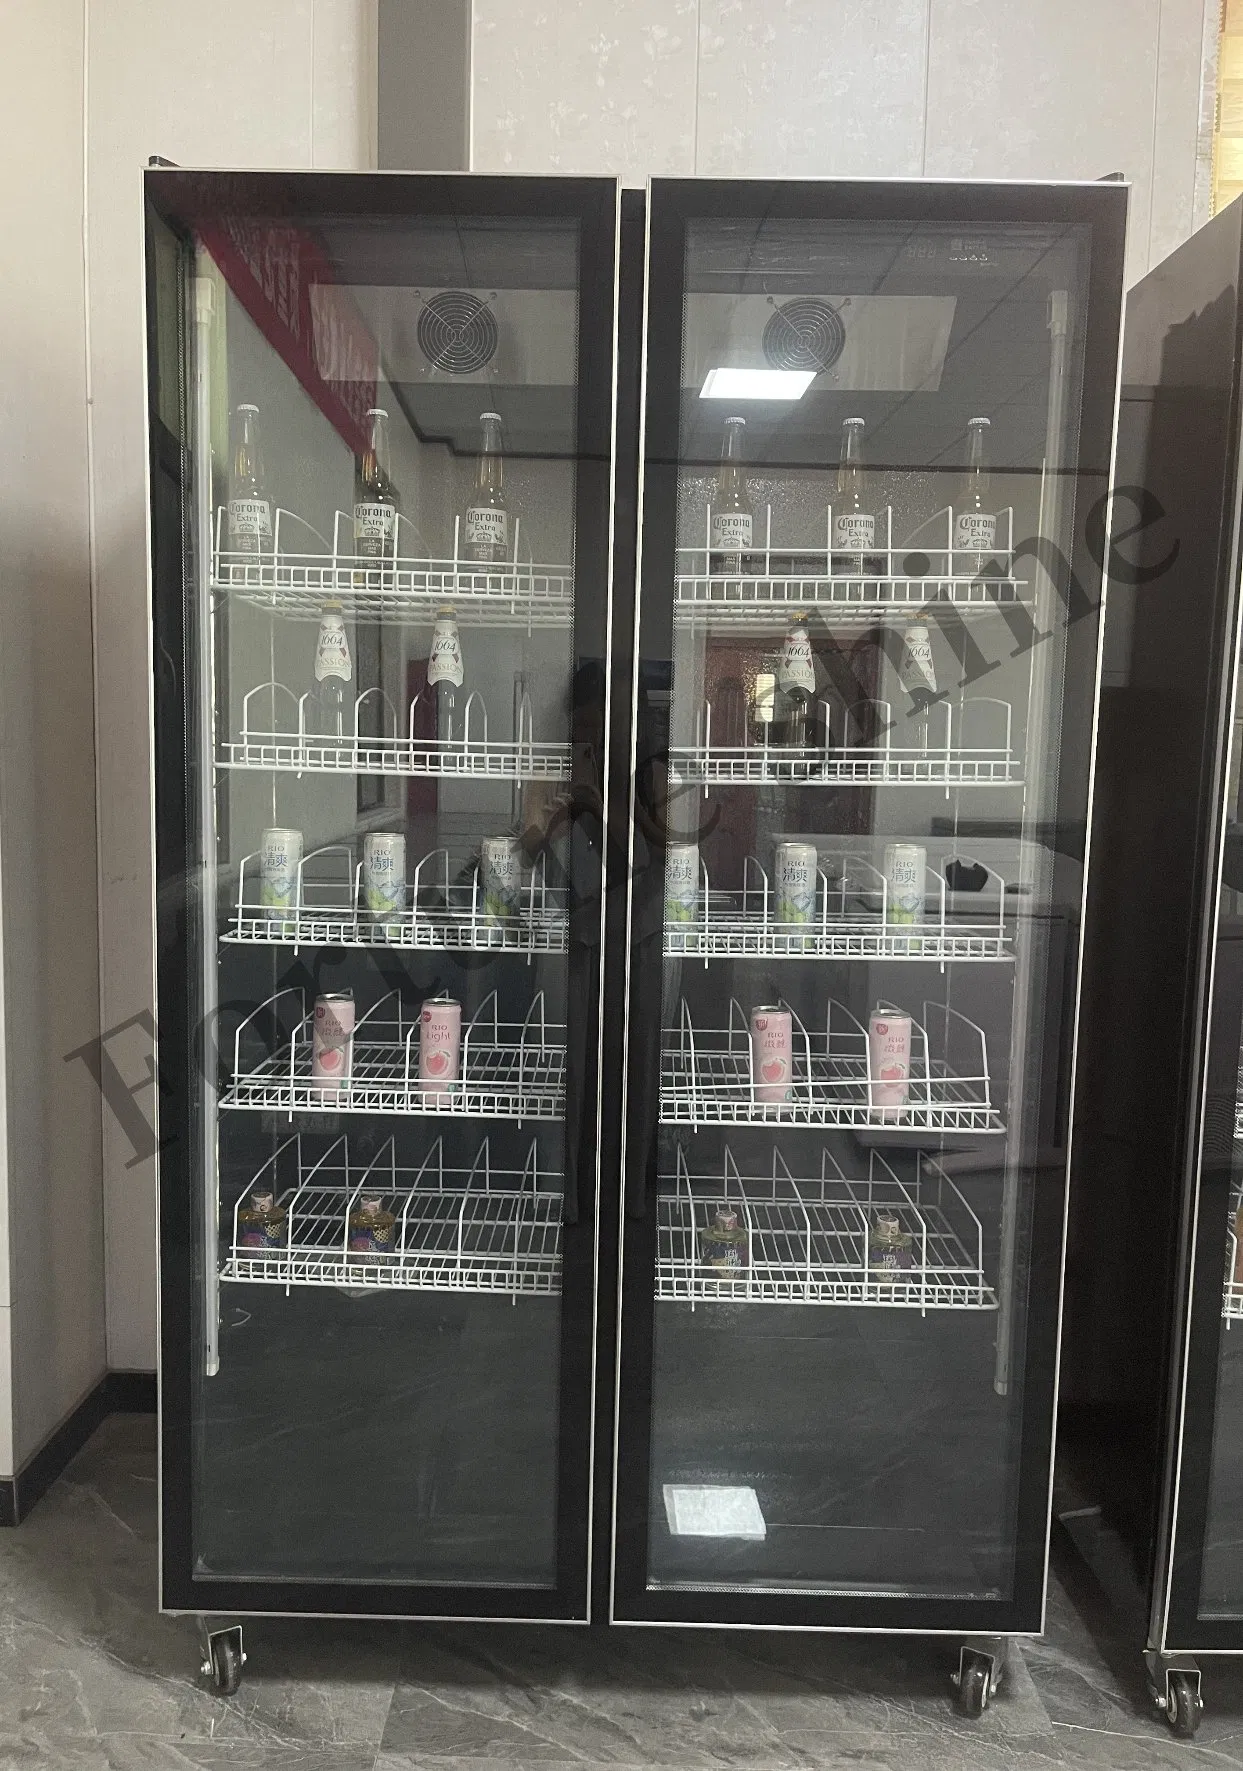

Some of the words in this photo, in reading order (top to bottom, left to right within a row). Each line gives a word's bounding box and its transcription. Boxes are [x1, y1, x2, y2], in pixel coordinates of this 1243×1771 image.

[230, 502, 266, 516] Corona
[355, 506, 391, 518] Corona
[236, 514, 258, 522] Extra
[363, 517, 384, 526] Extra
[468, 511, 503, 524] Corona
[713, 517, 750, 530] Corona
[475, 522, 496, 531] Extra
[838, 518, 874, 531] Corona
[722, 528, 743, 536] Extra
[971, 529, 991, 538] Extra
[321, 633, 343, 646] 1664
[434, 640, 456, 652] 1664
[787, 645, 810, 657] 1664
[908, 645, 930, 658] 1664
[264, 851, 289, 868] 清爽
[370, 856, 395, 872] 清爽
[489, 861, 515, 876] 清爽
[667, 865, 693, 880] 清爽
[783, 867, 808, 882] 清爽
[891, 867, 917, 883] 清爽
[426, 1032, 452, 1042] Light
